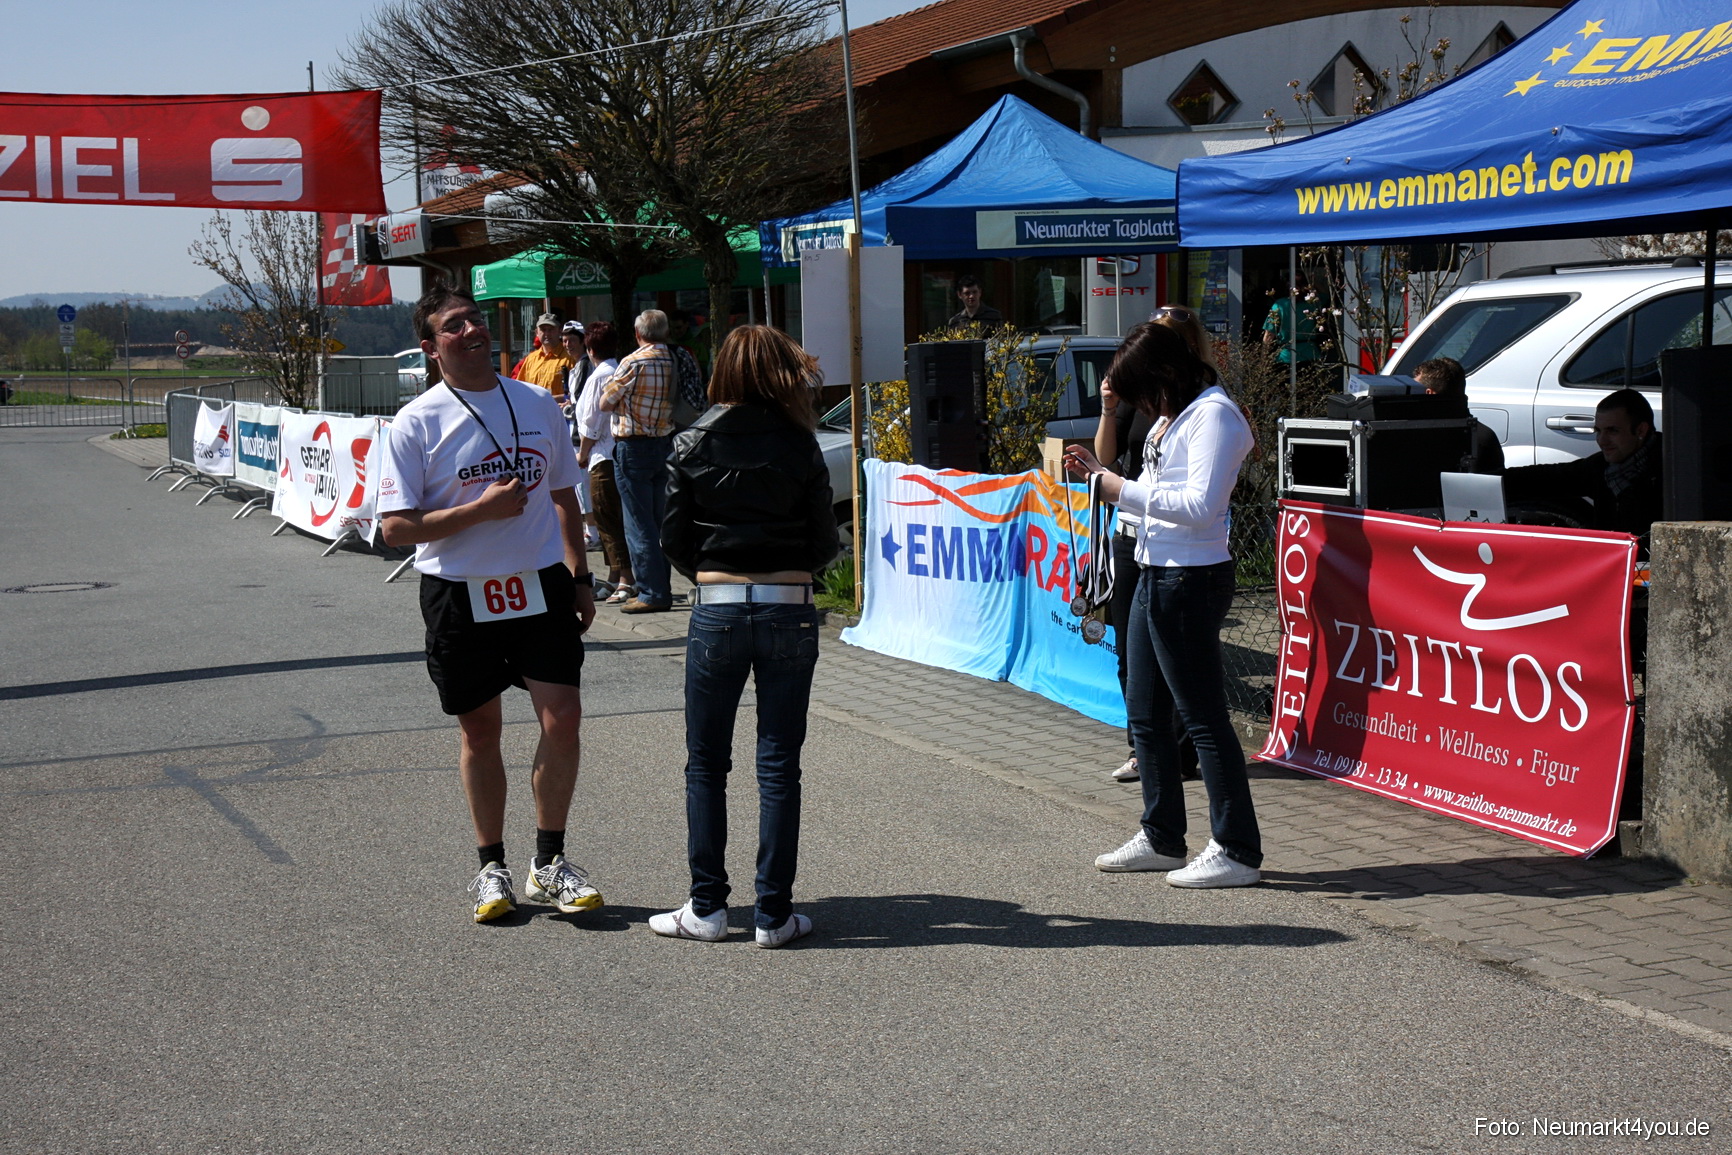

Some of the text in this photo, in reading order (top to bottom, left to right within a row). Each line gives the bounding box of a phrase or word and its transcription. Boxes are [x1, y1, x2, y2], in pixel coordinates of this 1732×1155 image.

[1554, 77, 1616, 88] european
[1616, 69, 1662, 84] mobile
[1296, 149, 1634, 215] www.emmanet.com
[391, 223, 417, 243] SEAT
[1024, 218, 1176, 239] Neumarkter Tagblatt
[557, 261, 611, 285] AOK
[1091, 287, 1149, 297] SEAT
[458, 457, 533, 480] GERHART
[462, 477, 496, 487] Autohaus
[483, 576, 528, 614] 69
[1051, 610, 1063, 626] the
[1269, 513, 1311, 761] ZEITLOS
[1334, 619, 1589, 732] ZEITLOS
[1333, 702, 1580, 787] Gesundheit Wellness Figur
[1313, 749, 1332, 769] Tel.
[1334, 756, 1367, 778] 09181
[1424, 783, 1577, 838] www.zeitlos-neumarkt.de
